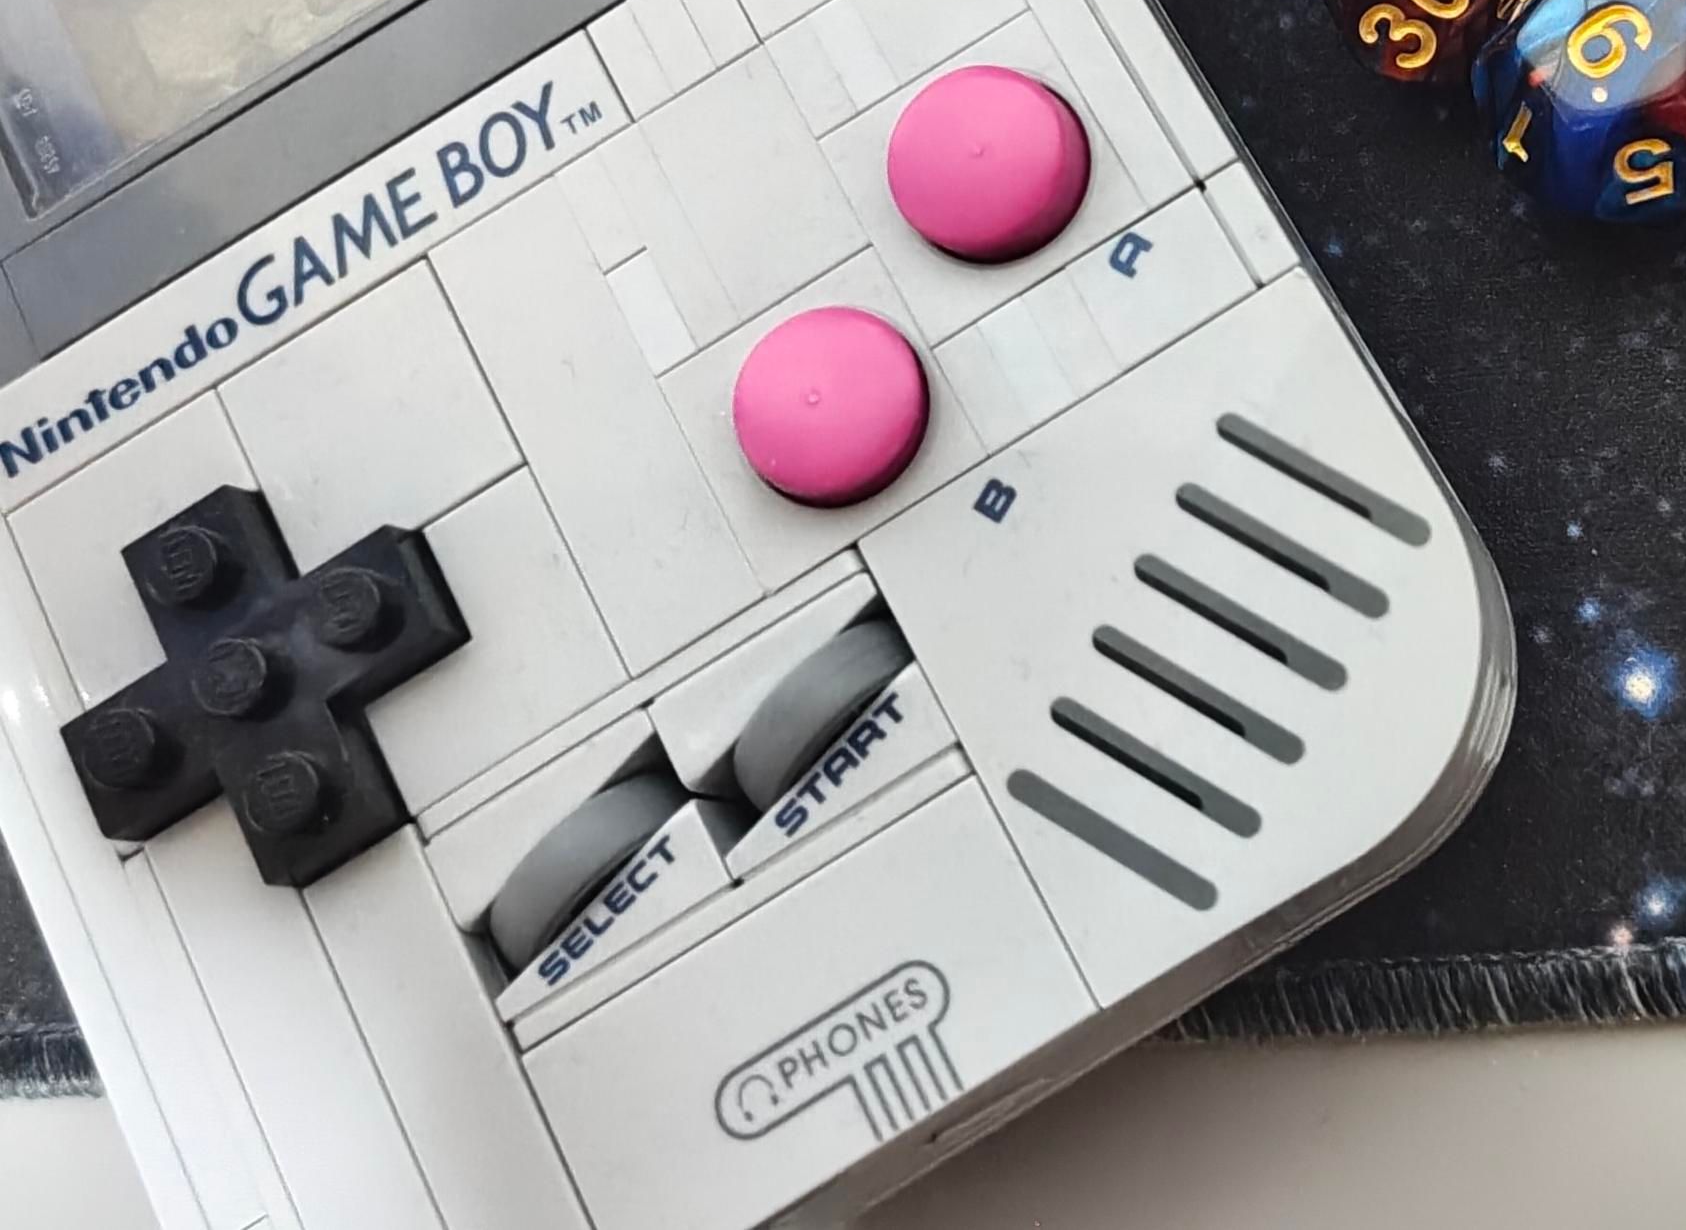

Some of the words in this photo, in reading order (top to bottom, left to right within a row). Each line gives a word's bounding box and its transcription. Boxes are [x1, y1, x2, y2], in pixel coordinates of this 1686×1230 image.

[1613, 138, 1675, 205] 5
[0, 314, 239, 478] Nintendo
[237, 167, 440, 326] GAME
[436, 81, 556, 208] BOY
[1109, 231, 1153, 278] A
[973, 478, 1017, 523] B
[774, 692, 905, 837] START
[537, 835, 677, 986] SELECT
[778, 977, 929, 1089] PHONES
